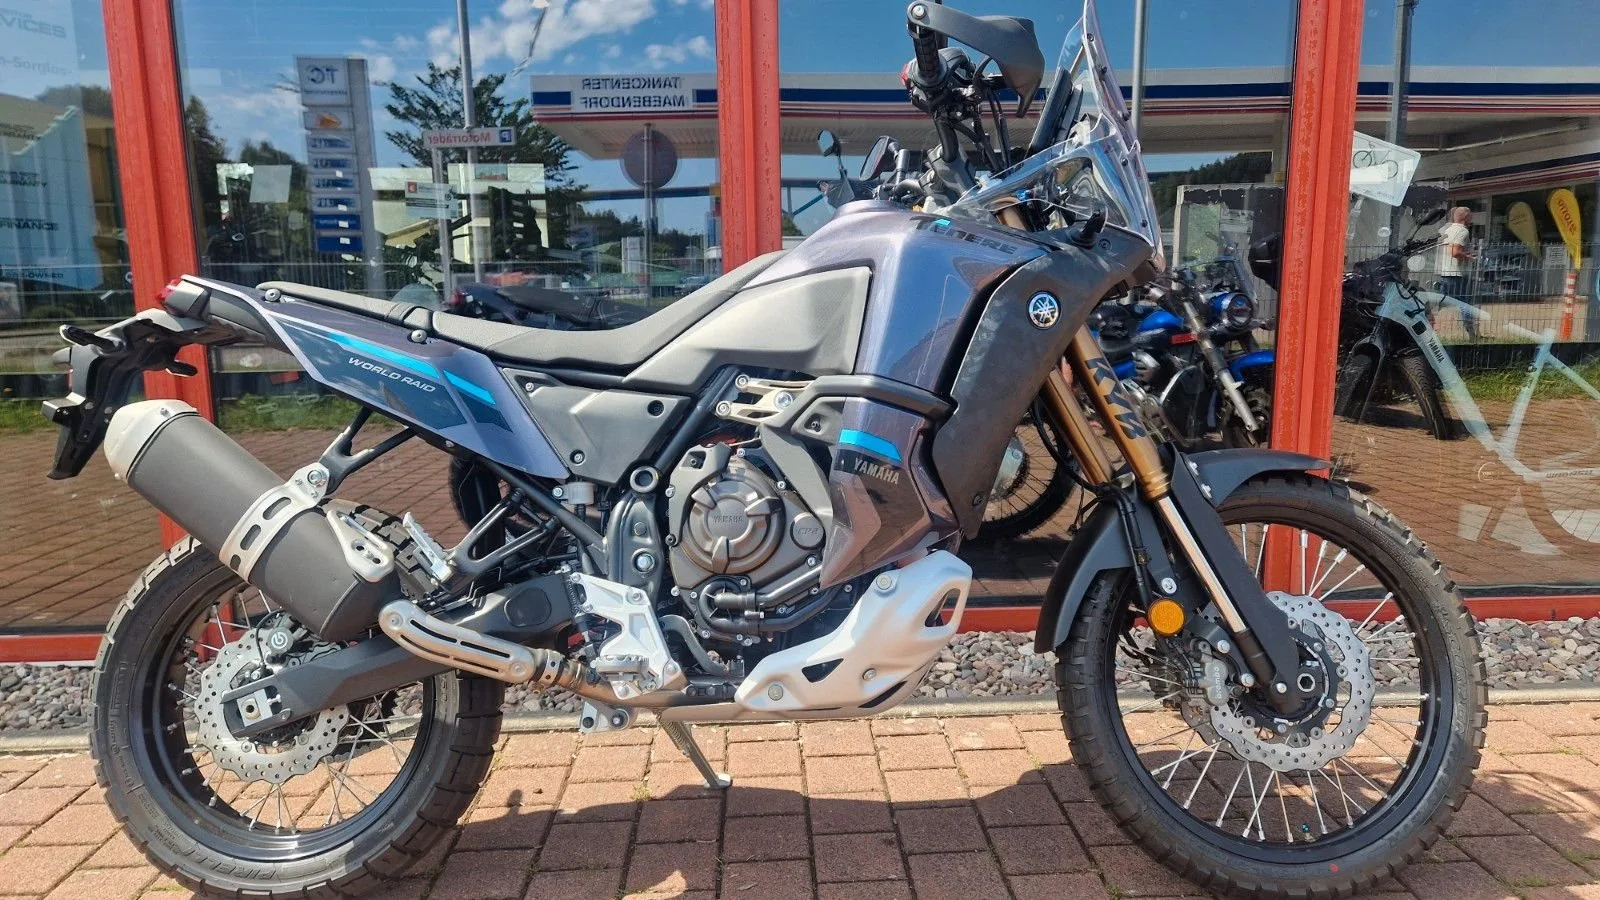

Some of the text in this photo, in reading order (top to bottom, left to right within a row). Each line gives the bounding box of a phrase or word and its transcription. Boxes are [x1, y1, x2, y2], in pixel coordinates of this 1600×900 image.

[1427, 337, 1445, 363] YAMAHA
[348, 357, 436, 392] WORLD RAID
[1086, 357, 1147, 439] KYB
[854, 457, 900, 485] YAMAHA
